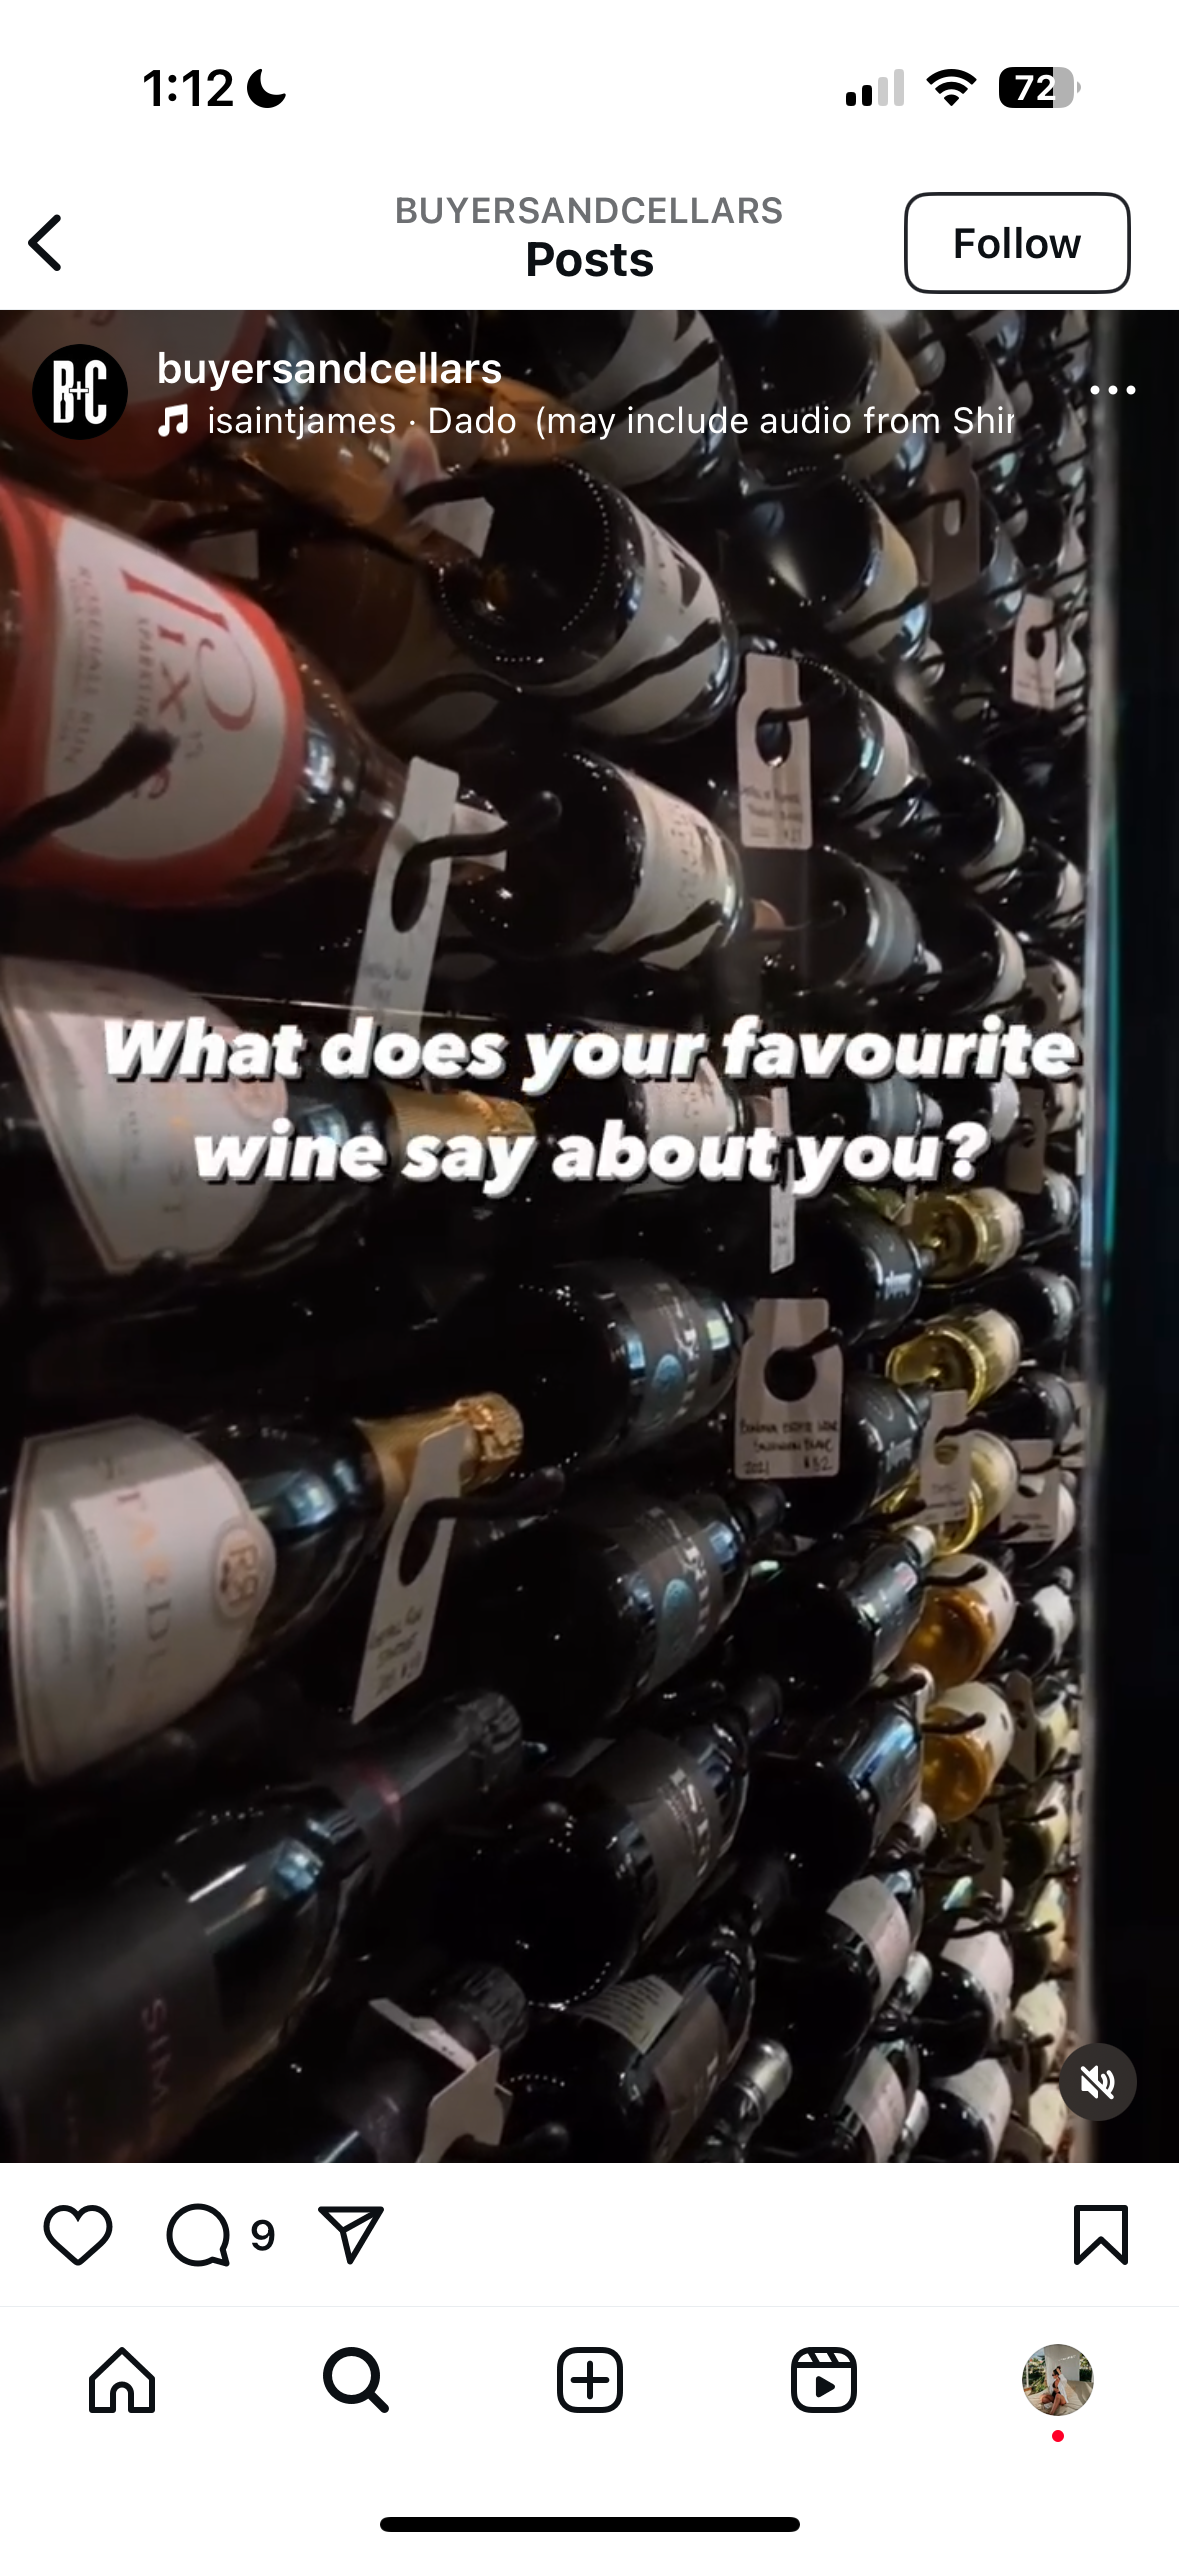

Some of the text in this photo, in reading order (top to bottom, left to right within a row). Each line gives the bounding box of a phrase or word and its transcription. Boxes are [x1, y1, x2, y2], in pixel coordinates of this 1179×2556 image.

[143, 69, 233, 107] 1:12
[1015, 74, 1054, 101] 72
[395, 196, 783, 225] BUYERSANDCELLARS
[526, 241, 654, 278] Posts
[954, 225, 1082, 260] Follow
[158, 351, 503, 392] buyersandcellars
[208, 406, 396, 440] isaintjames
[428, 406, 517, 434] Dado
[536, 406, 616, 440] (may
[627, 406, 748, 434] include
[759, 406, 851, 434] audio
[862, 406, 940, 434] from
[250, 2218, 276, 2253] 9
